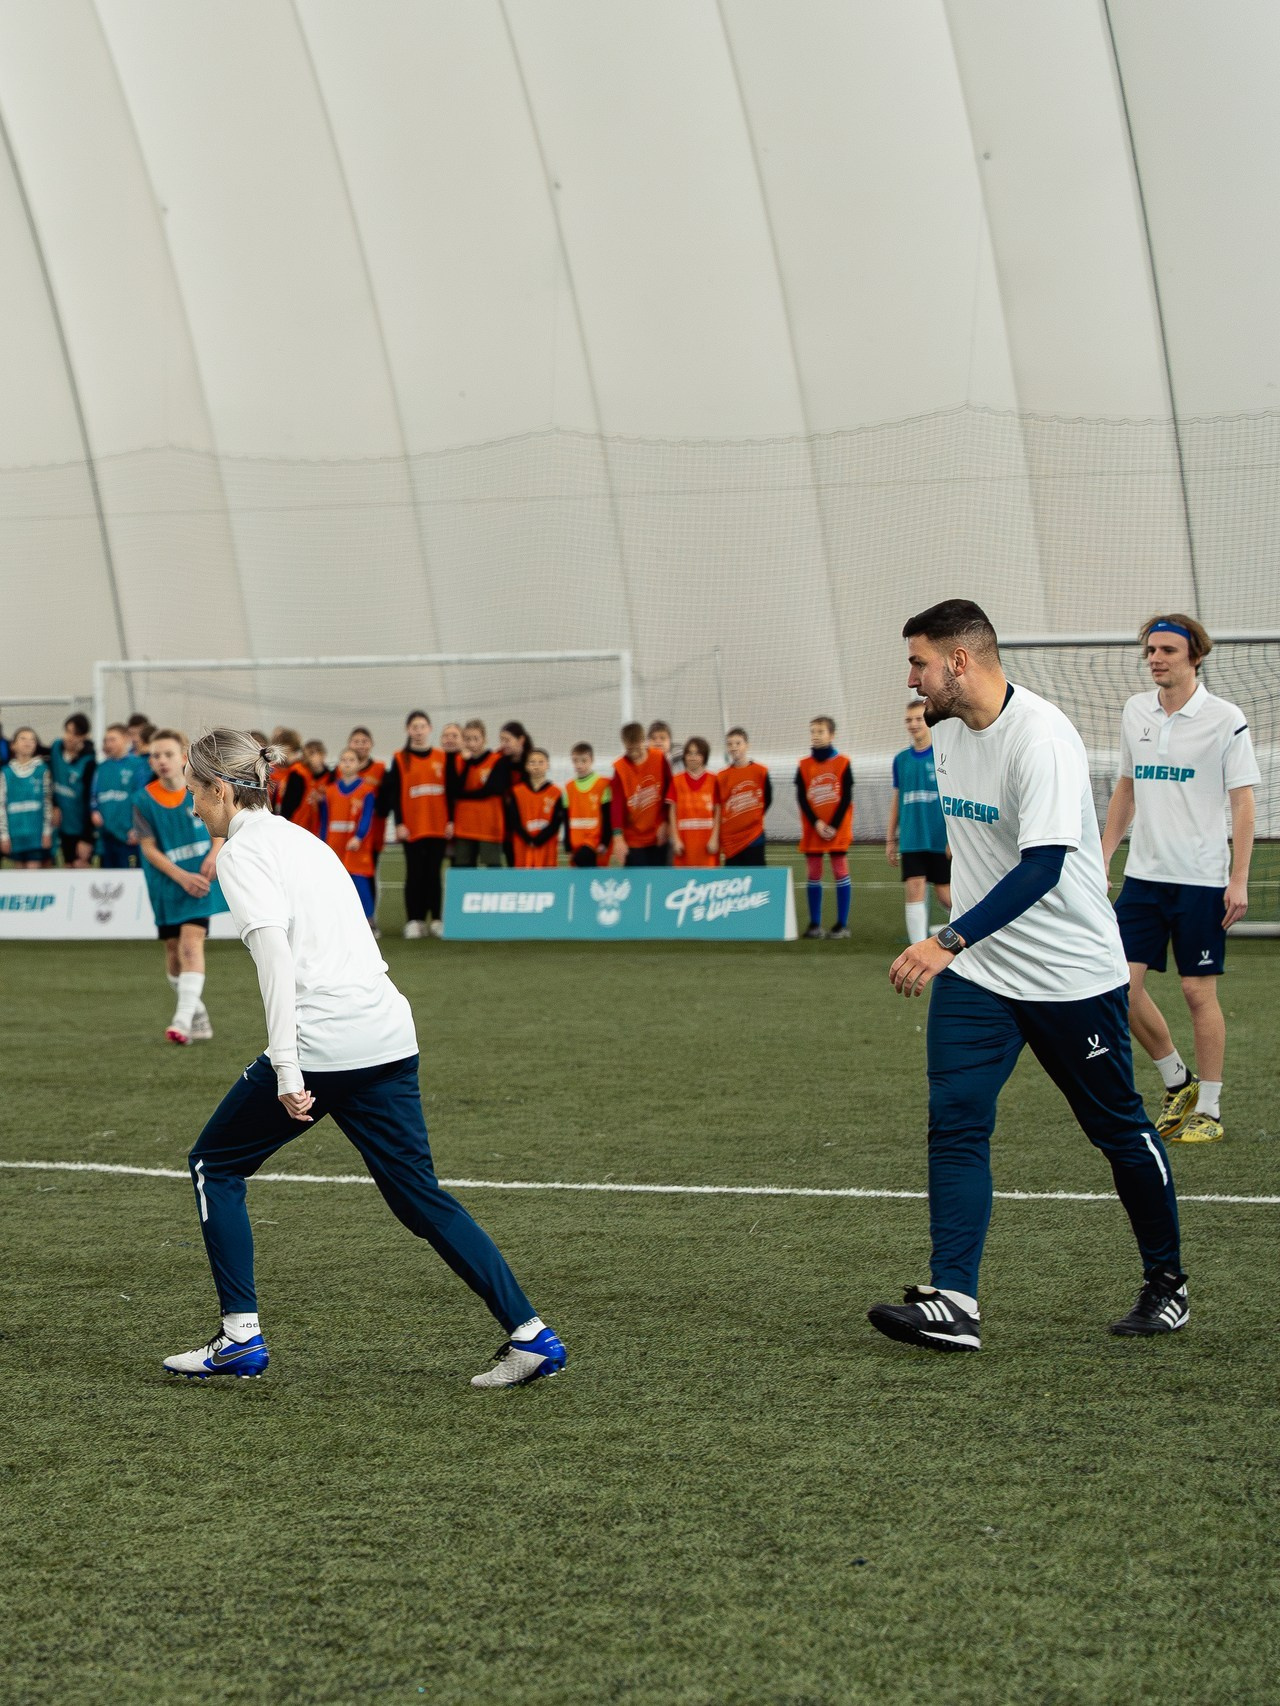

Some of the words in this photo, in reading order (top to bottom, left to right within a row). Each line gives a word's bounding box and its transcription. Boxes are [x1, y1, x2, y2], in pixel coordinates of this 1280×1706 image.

[1135, 765, 1195, 782] СИБУР
[942, 795, 999, 825] СИБУР
[462, 891, 556, 914] СИБУР
